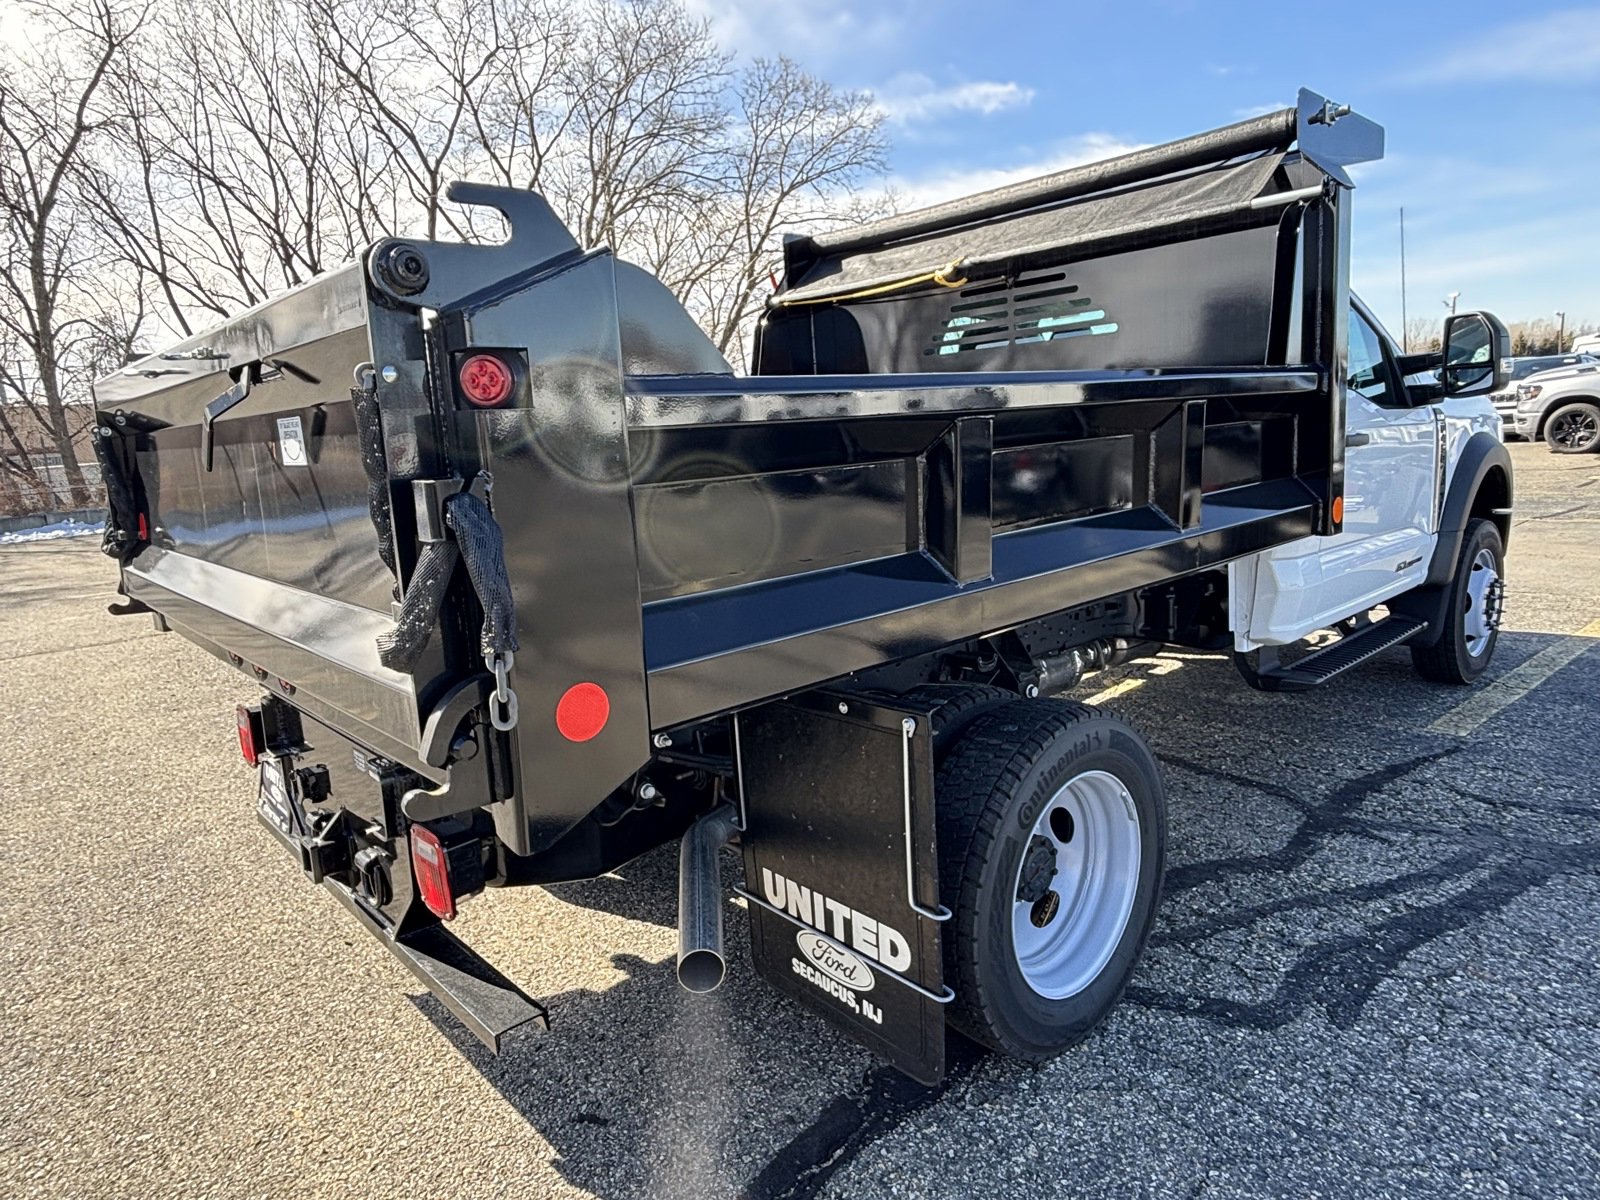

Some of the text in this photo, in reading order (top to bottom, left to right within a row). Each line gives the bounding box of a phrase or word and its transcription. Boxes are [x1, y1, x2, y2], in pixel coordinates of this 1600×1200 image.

[1018, 733, 1091, 830] Continental
[762, 867, 912, 972] UNITED
[812, 939, 857, 981] Ford
[791, 957, 883, 1025] SECAUCUS, NJ
